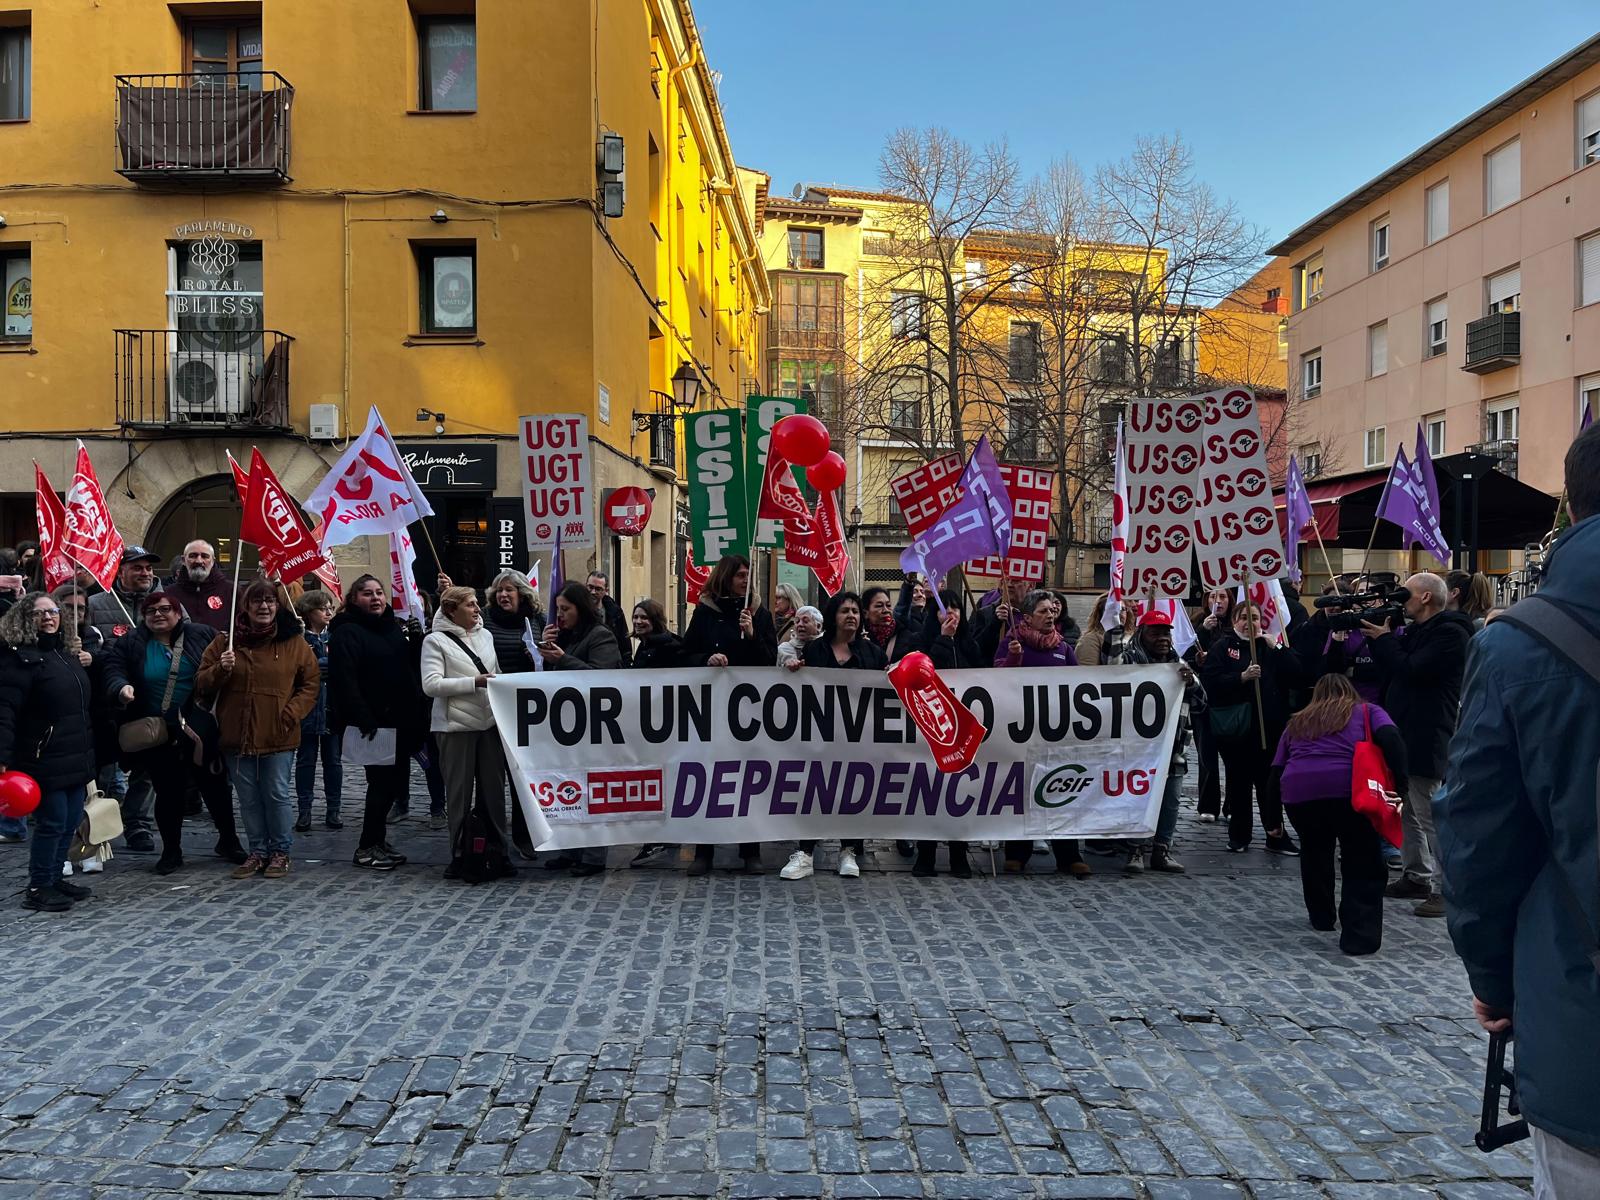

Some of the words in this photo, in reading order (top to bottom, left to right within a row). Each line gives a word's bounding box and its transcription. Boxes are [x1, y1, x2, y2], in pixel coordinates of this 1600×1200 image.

[243, 44, 263, 56] VIDA
[175, 221, 253, 237] PARLAMENTO
[184, 279, 243, 291] ROYAL
[12, 293, 32, 309] Leff
[174, 296, 254, 315] BLISS
[1131, 403, 1202, 433] USO
[1203, 390, 1253, 425] SO
[525, 419, 580, 449] UGT
[402, 451, 483, 473] Parlamento
[527, 453, 582, 484] UGT
[1128, 444, 1198, 474] USO
[893, 454, 963, 499] CCOO
[530, 487, 585, 518] UGT
[1127, 485, 1194, 514] USO
[1194, 506, 1274, 546] USO
[1412, 519, 1437, 548] CCOO
[499, 520, 515, 574] BEE
[1202, 548, 1282, 587] USO
[516, 687, 625, 747] POR
[639, 684, 712, 744] UN
[727, 681, 995, 744] CONVEO
[1008, 680, 1166, 744] JUSTO
[588, 779, 661, 805] CCOO
[671, 760, 1025, 819] DEPENDENCIA
[1046, 777, 1095, 794] CSIF
